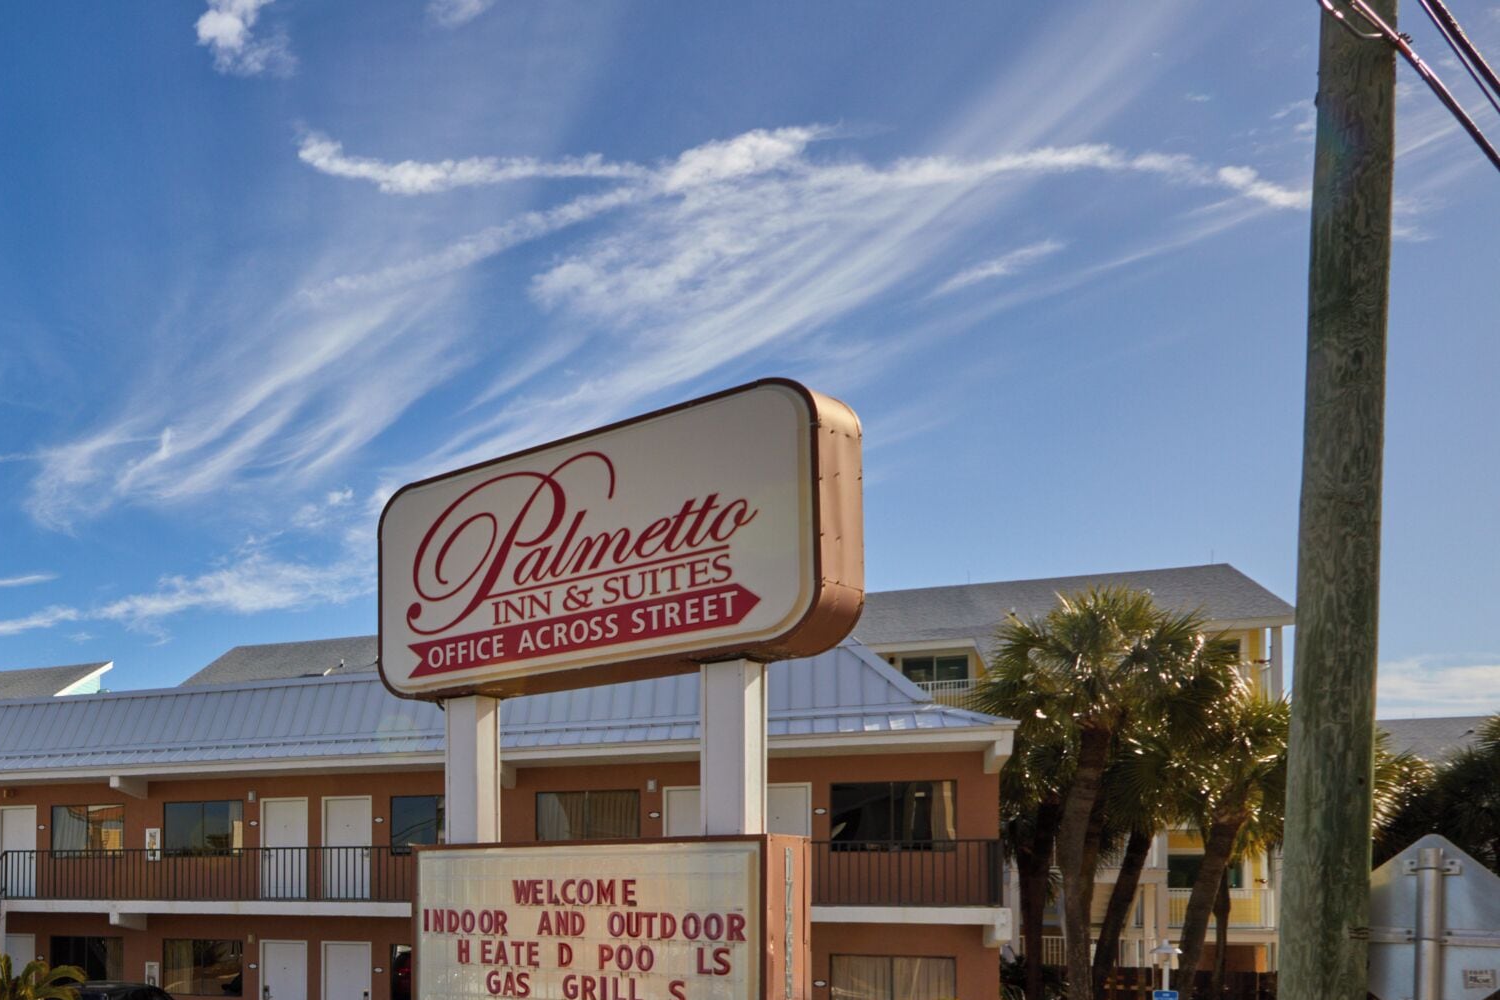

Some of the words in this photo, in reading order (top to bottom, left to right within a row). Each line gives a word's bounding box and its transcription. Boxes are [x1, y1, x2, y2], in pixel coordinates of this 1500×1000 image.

[406, 451, 758, 635] Palmetto
[492, 592, 553, 626] INN
[562, 584, 595, 612] &
[601, 553, 733, 604] SUITES
[427, 634, 505, 668] OFFICE
[517, 615, 619, 655] ACROSS
[630, 590, 738, 634] STREET
[512, 879, 638, 907] WELCOME
[423, 908, 509, 936] INDOOR
[536, 911, 587, 938] AND
[606, 911, 747, 942] OUTDOOR
[486, 971, 531, 999] GAS
